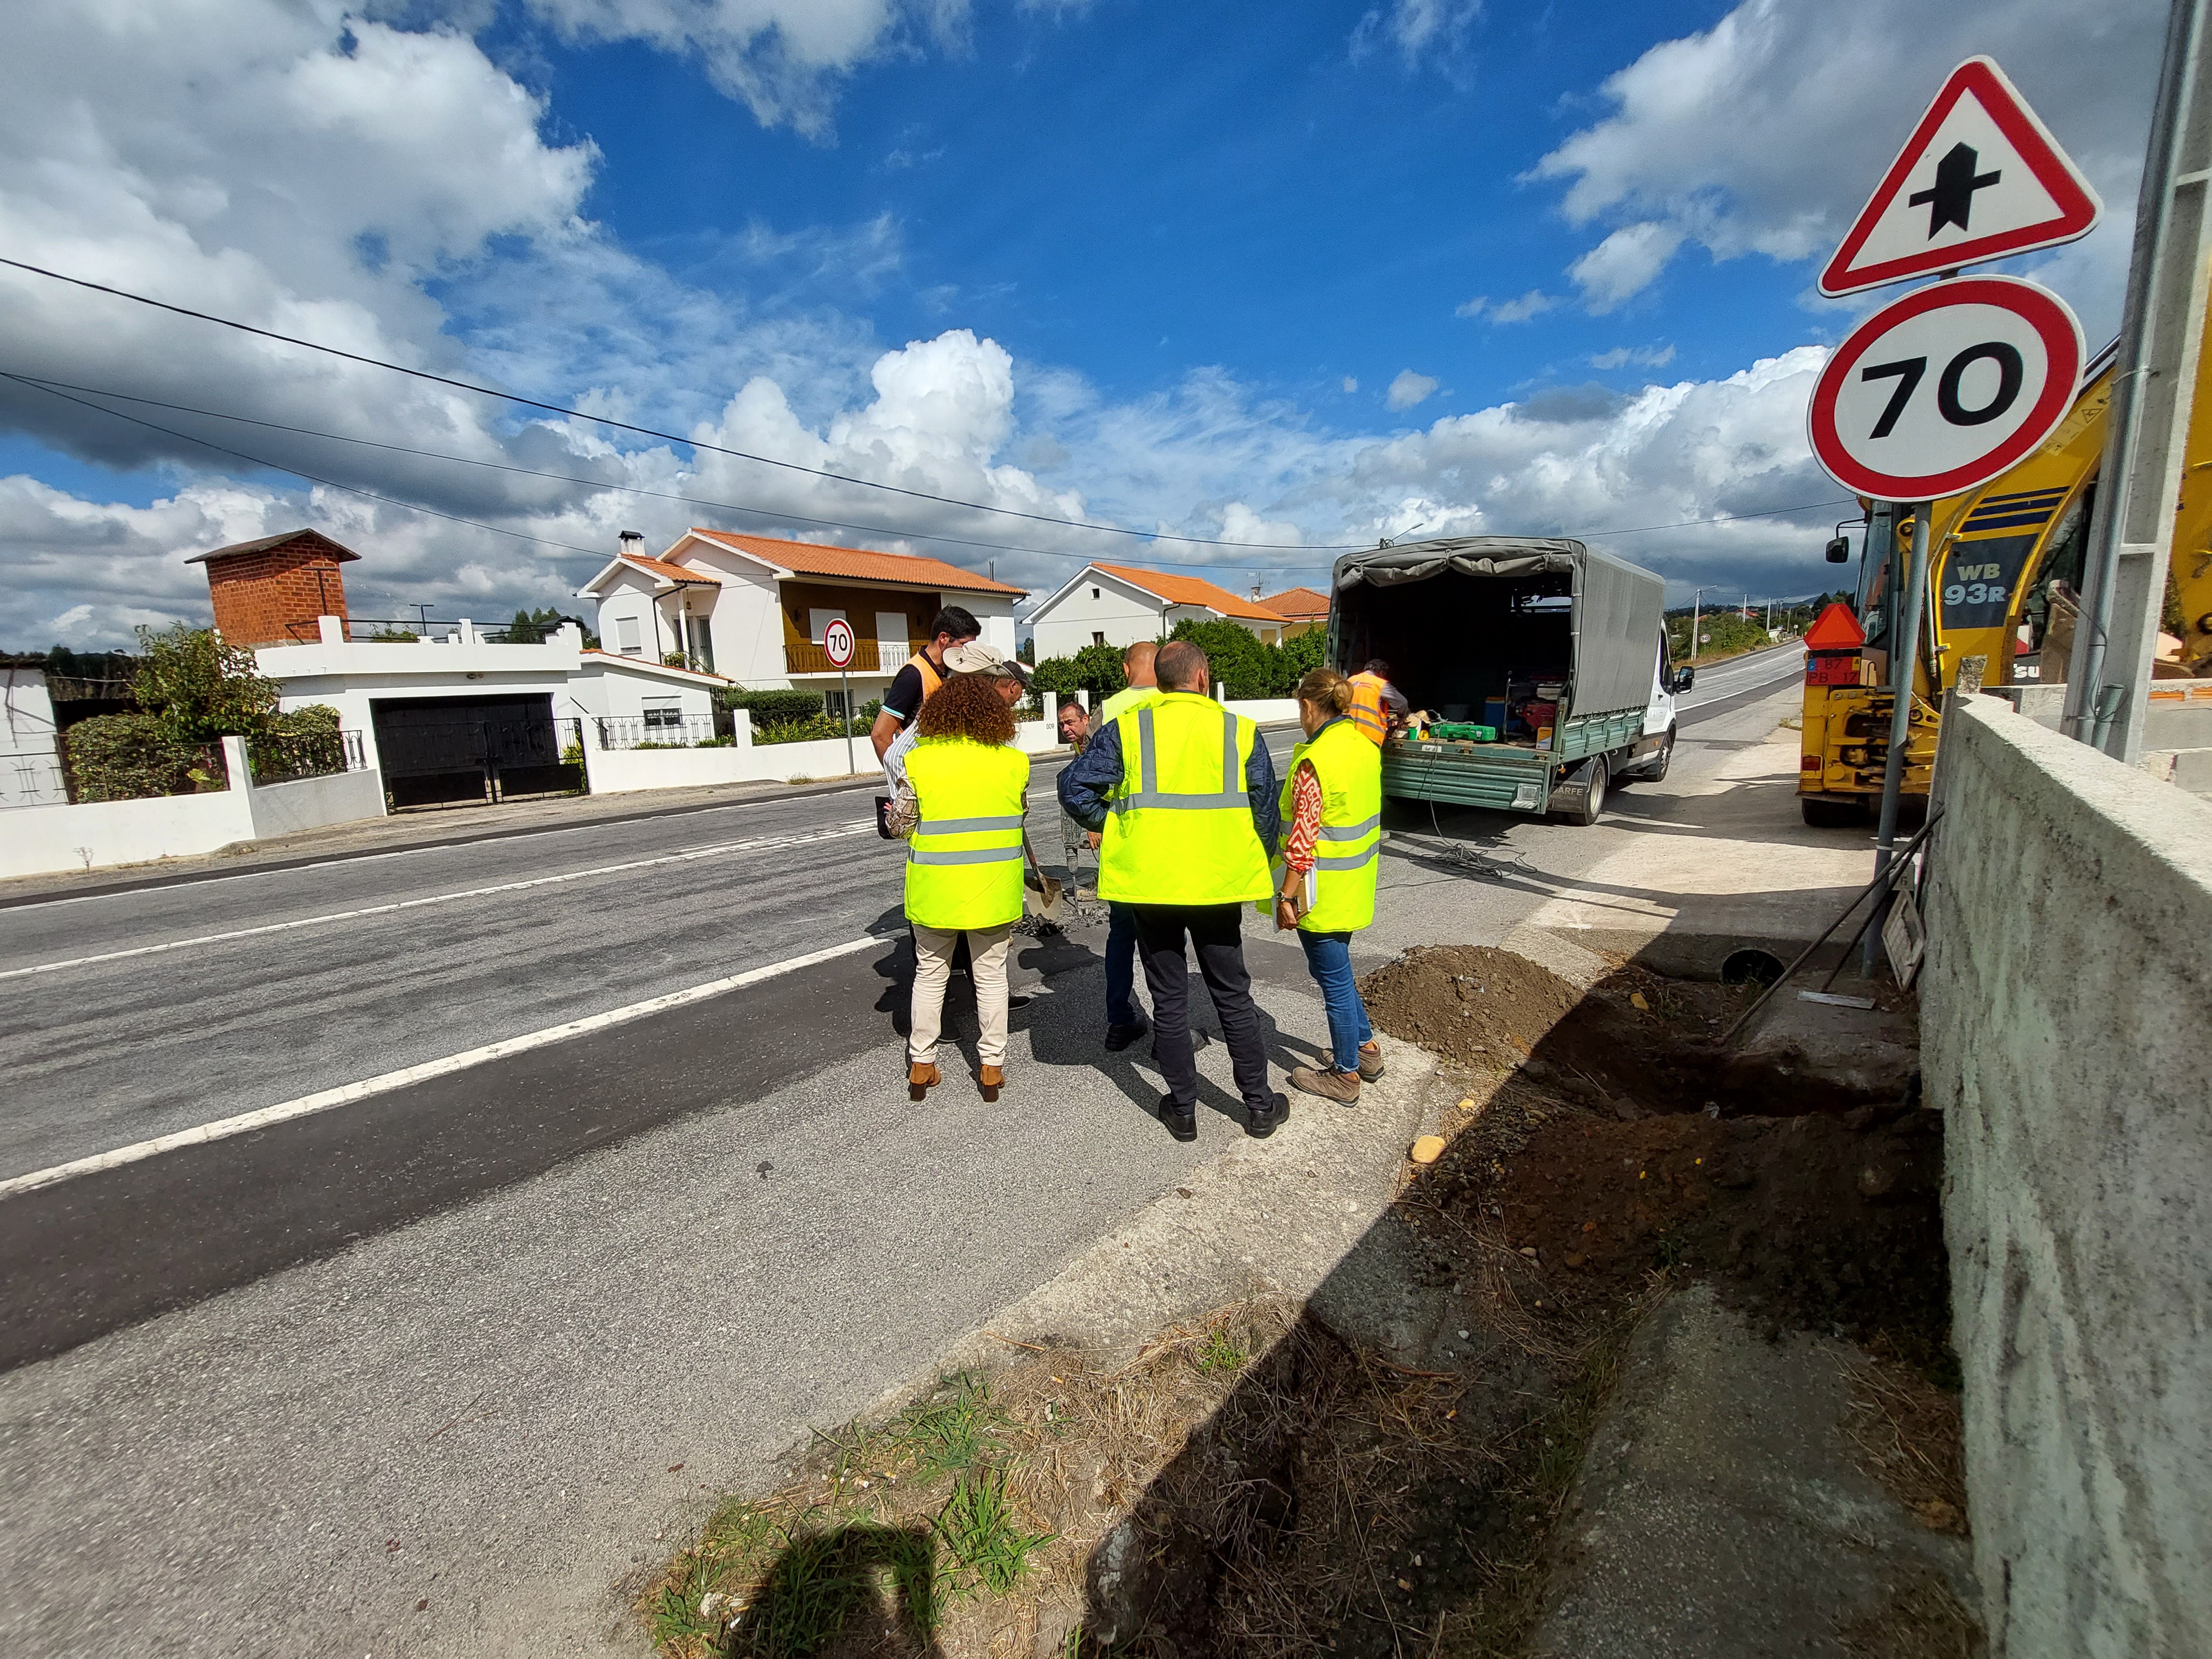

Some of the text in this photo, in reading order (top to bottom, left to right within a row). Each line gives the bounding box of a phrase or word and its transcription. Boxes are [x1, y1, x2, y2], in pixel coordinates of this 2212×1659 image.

[1861, 341, 2023, 440] 70
[1957, 563, 2000, 581] WB
[1944, 583, 2006, 606] 93R
[830, 633, 848, 652] 70
